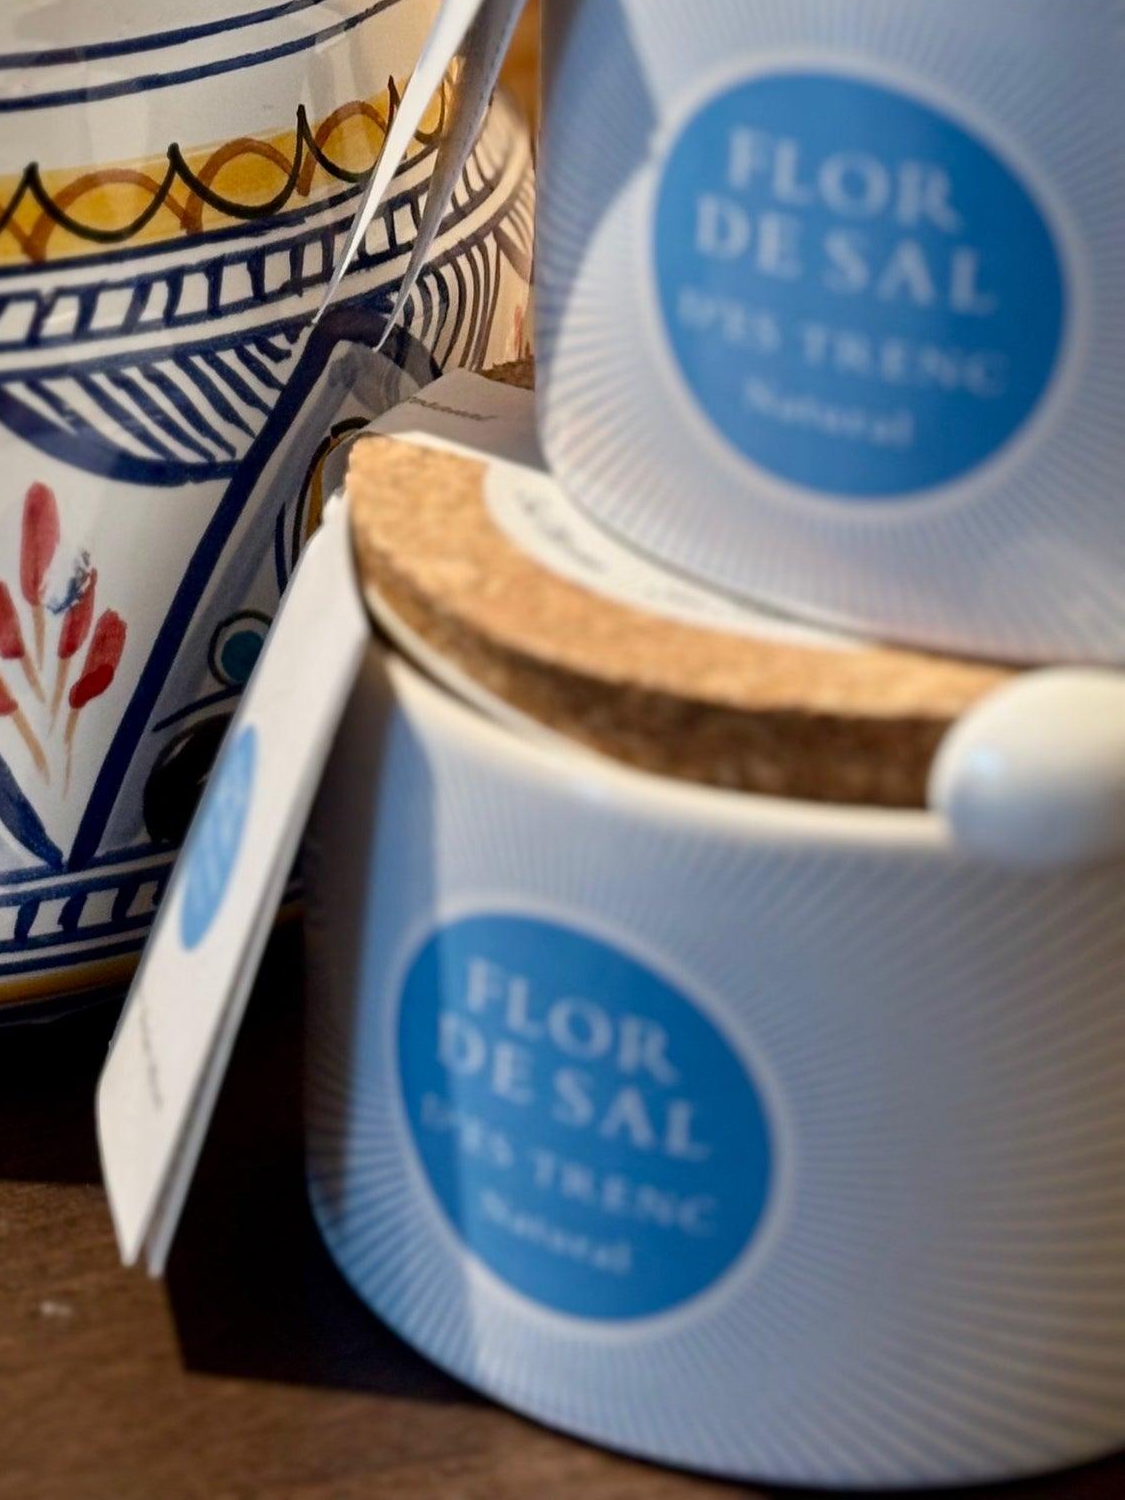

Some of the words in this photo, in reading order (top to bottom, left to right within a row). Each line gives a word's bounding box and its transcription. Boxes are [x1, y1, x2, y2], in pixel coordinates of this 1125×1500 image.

[728, 125, 963, 234] FLOR
[695, 193, 802, 281] DE
[823, 226, 996, 316] SAL
[802, 322, 1008, 399] TRENC
[742, 376, 915, 448] Natural
[466, 956, 680, 1086] FLOR
[438, 1010, 535, 1106] DE
[551, 1066, 712, 1163] SAL
[481, 1190, 633, 1276] Natural
[530, 1148, 718, 1237] TRENC
